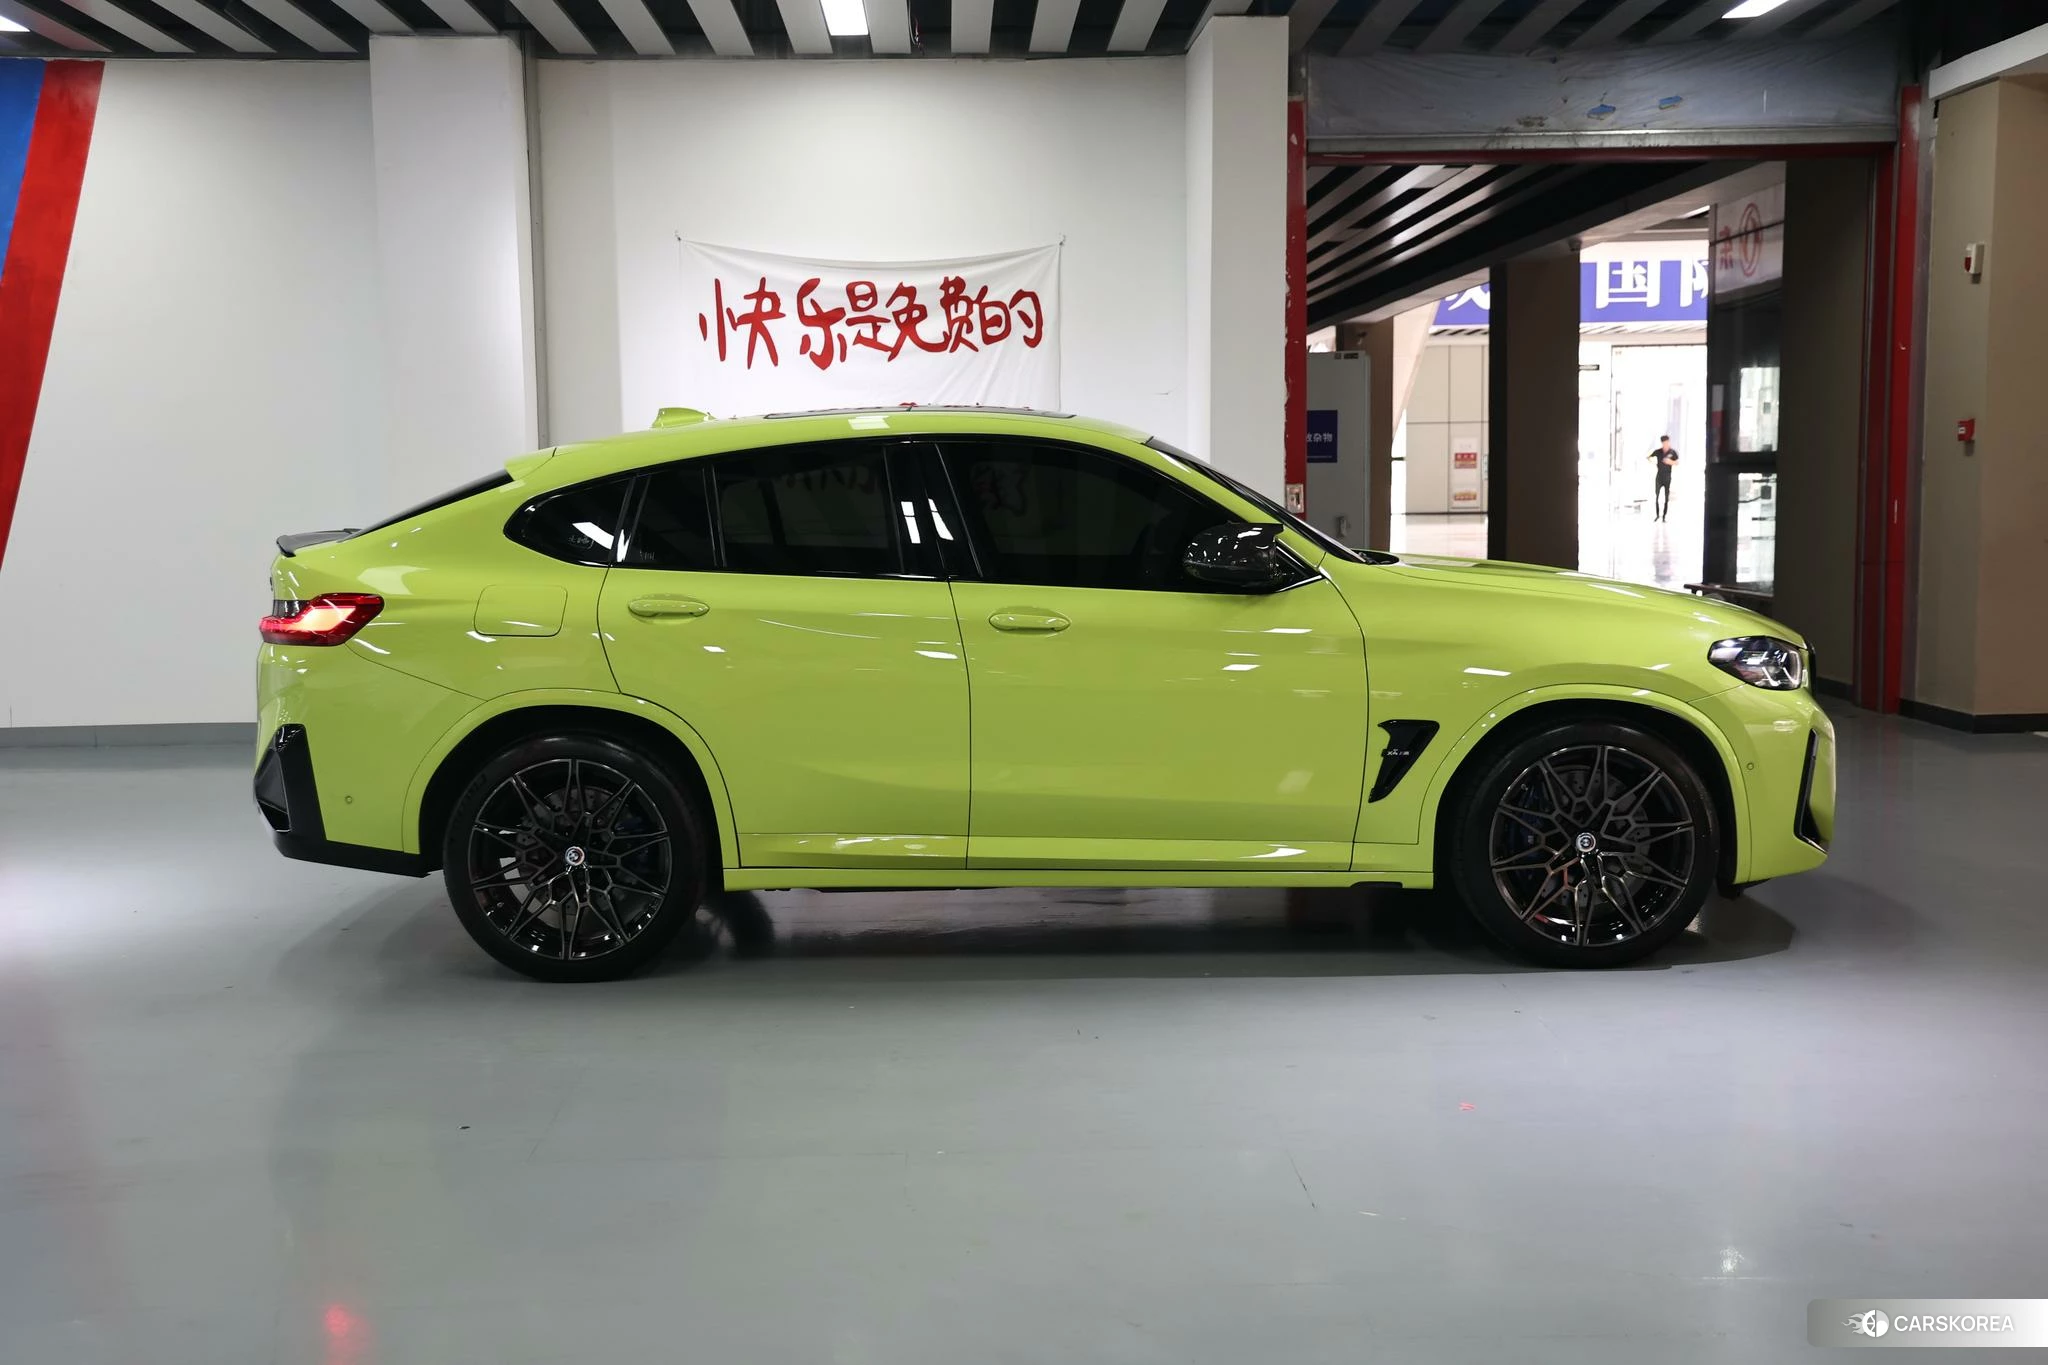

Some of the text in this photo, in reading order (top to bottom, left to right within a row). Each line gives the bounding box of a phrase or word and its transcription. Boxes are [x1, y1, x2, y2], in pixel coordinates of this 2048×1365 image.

[699, 276, 1043, 370] 快乐是免费的
